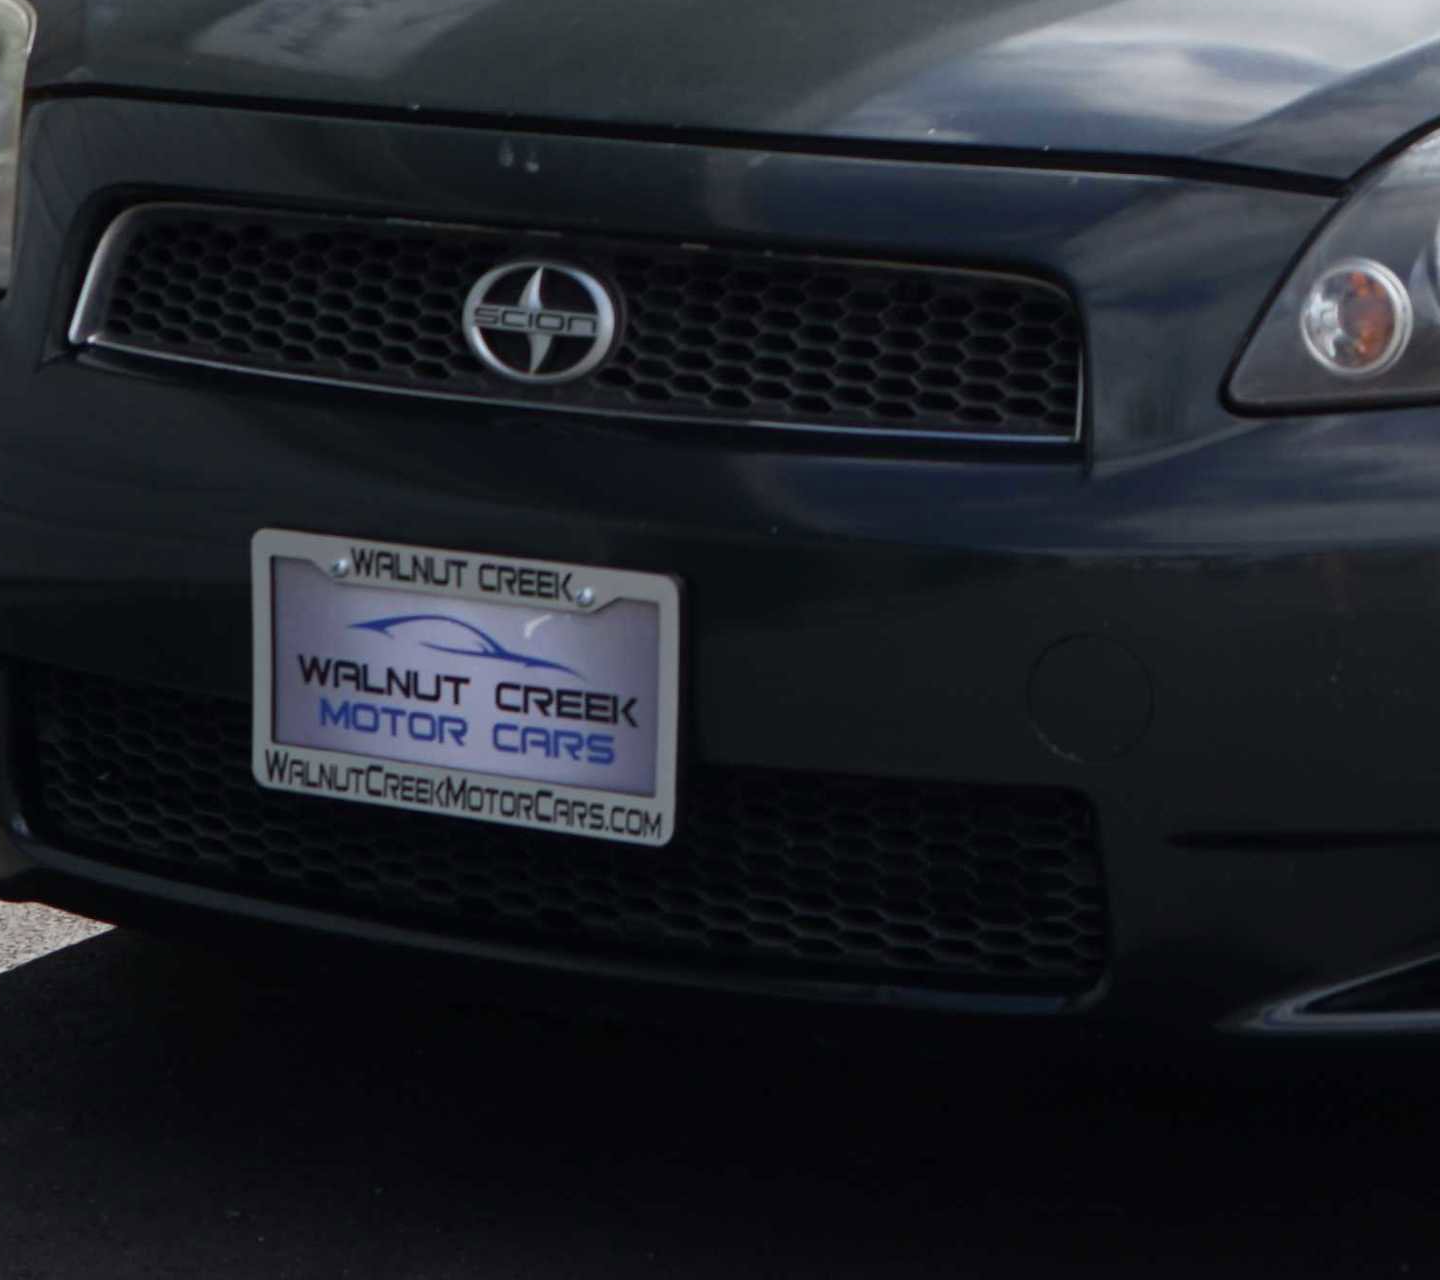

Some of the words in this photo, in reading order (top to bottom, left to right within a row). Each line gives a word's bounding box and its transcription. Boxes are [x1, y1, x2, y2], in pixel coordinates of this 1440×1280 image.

[351, 547, 469, 588] WALNUT
[478, 563, 574, 602] CREEK
[295, 652, 471, 706] WALNUT
[494, 682, 640, 729] CREEK
[318, 696, 469, 746] MOTOR
[491, 723, 617, 766] CARS
